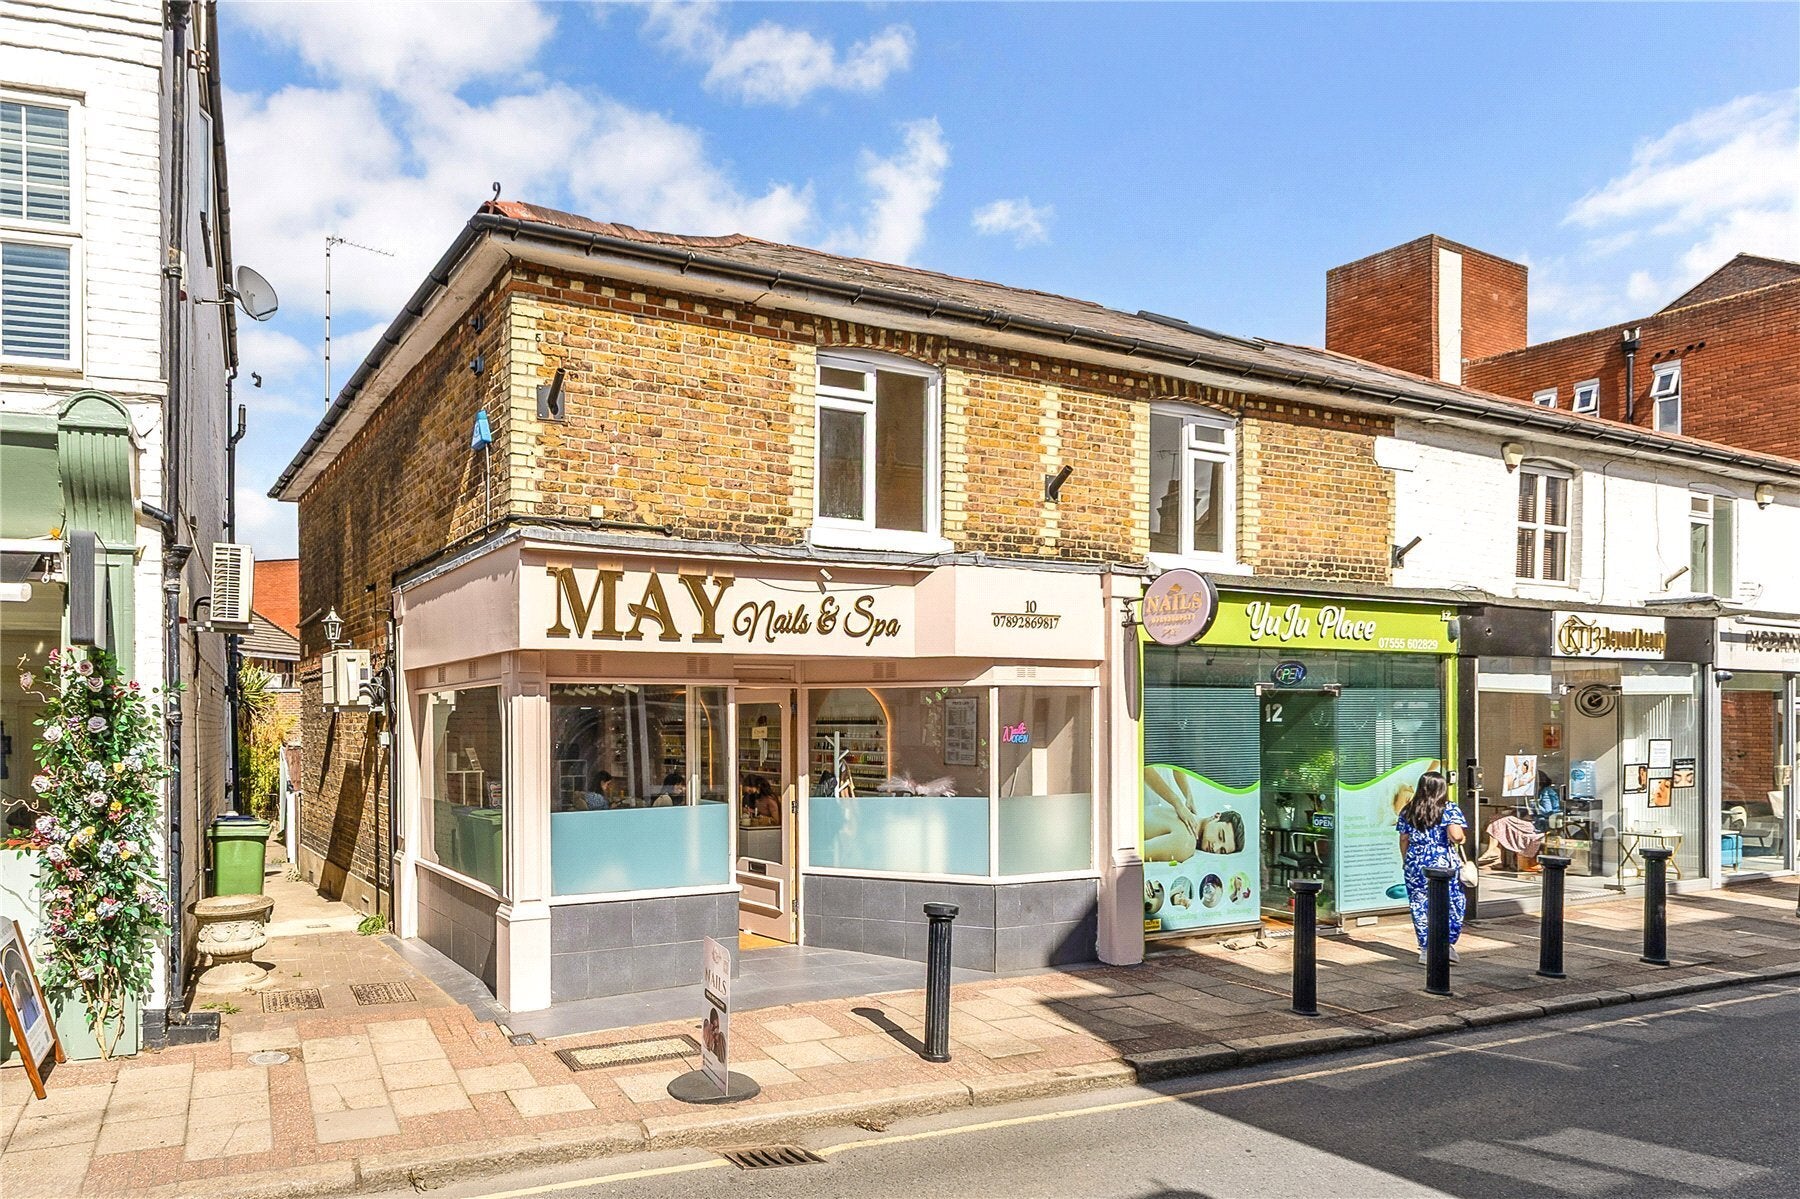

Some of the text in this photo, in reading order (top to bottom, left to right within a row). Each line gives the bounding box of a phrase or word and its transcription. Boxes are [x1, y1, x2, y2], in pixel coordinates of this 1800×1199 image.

[546, 567, 901, 647] MAY Nails & Spa
[1025, 600, 1037, 614] 10
[1145, 591, 1203, 614] NAILS
[993, 615, 1059, 629] 07892869817
[1317, 605, 1377, 641] Place
[1378, 637, 1438, 650] 07555 602829
[1276, 668, 1304, 680] OPEN
[1265, 703, 1283, 722] 12
[1314, 818, 1333, 827] OPEN
[705, 968, 727, 996] NAILS
